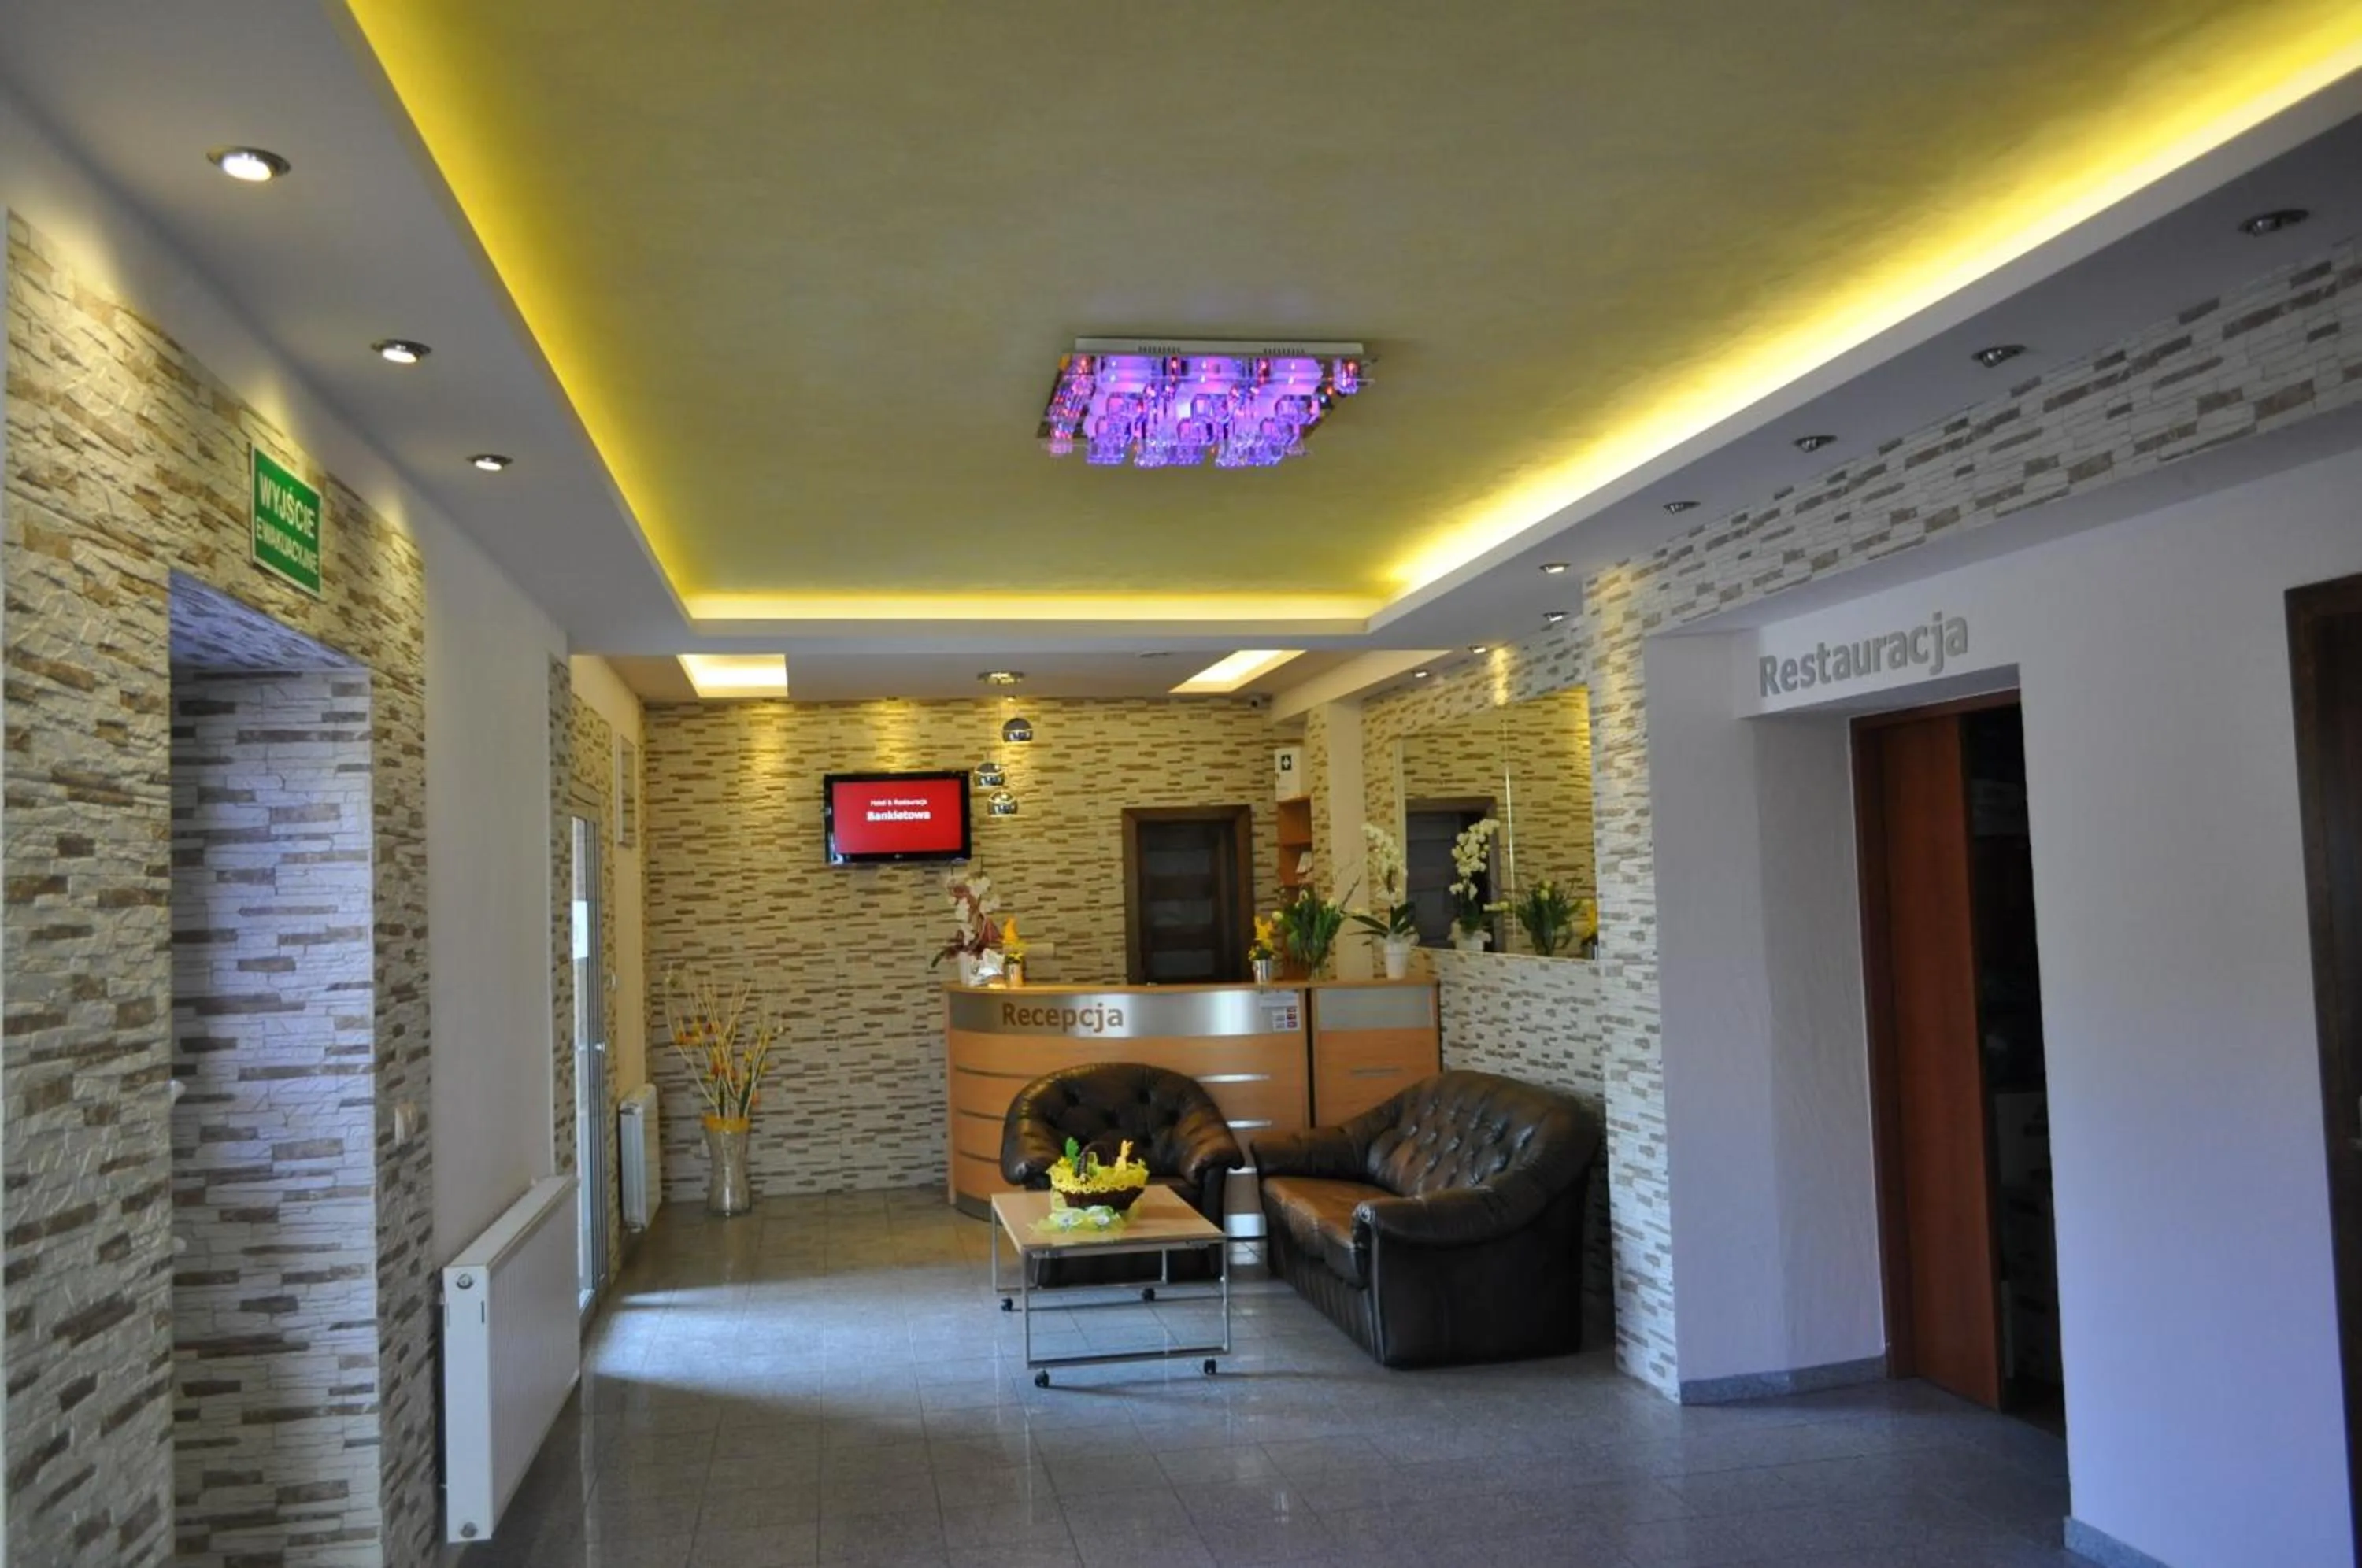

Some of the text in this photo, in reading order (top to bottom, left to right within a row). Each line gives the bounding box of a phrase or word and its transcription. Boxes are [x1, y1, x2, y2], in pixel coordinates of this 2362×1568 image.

[258, 471, 315, 540] WYJŚCIE
[1759, 611, 1968, 697] Restauracja
[867, 810, 931, 821] Bankietowa
[1001, 1001, 1124, 1034] Recepcja
